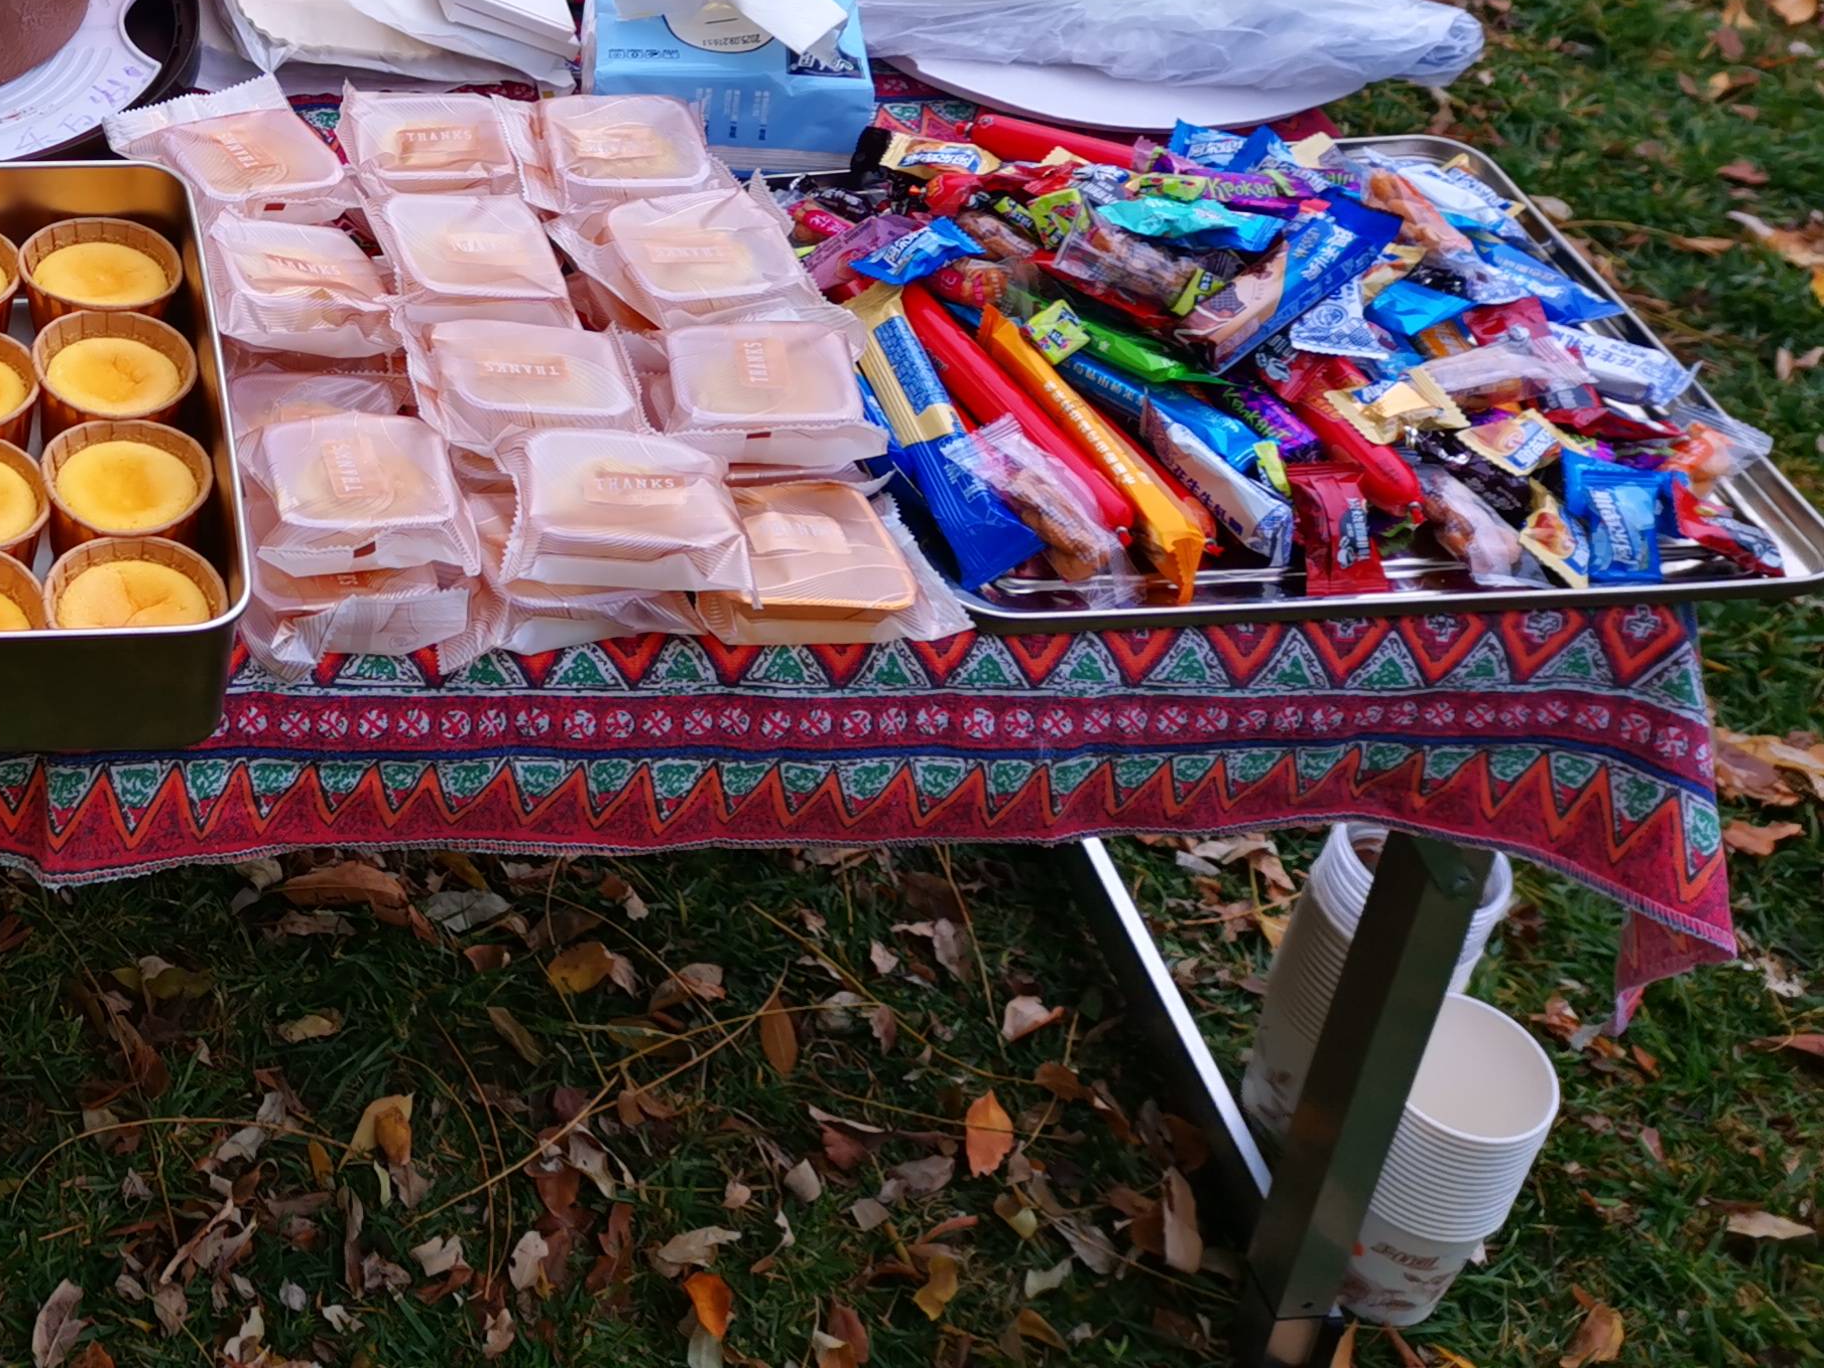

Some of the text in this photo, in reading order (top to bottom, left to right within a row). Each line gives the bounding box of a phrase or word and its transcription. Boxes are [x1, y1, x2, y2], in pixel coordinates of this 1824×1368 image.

[406, 129, 474, 143] THANKS
[482, 360, 561, 377] THANKS
[748, 340, 771, 385] THANKS
[593, 475, 677, 492] THANKS
